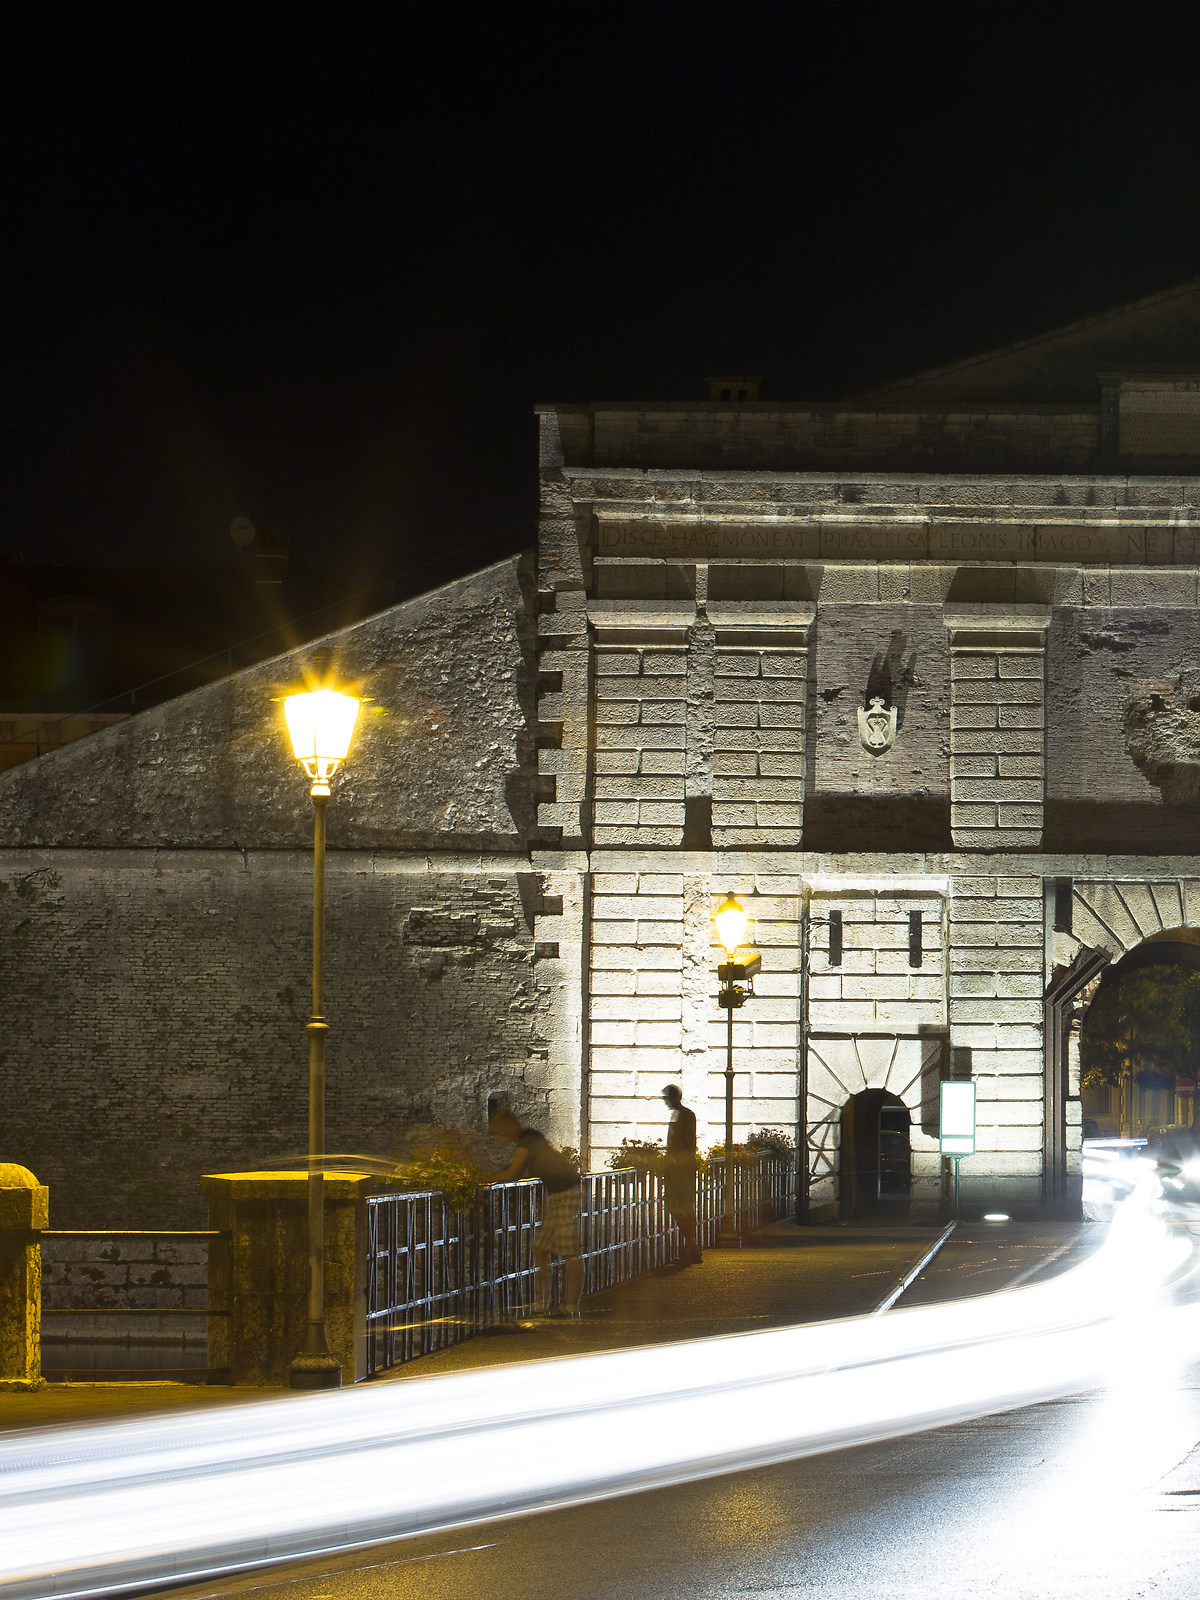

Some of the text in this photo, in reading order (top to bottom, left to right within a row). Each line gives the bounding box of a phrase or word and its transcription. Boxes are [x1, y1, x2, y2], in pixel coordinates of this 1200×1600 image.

[601, 526, 663, 548] DISCE
[722, 531, 809, 549] MONEAT
[938, 532, 1008, 550] LEONIS
[1018, 534, 1091, 551] IMAGO
[1126, 534, 1160, 556] NE
